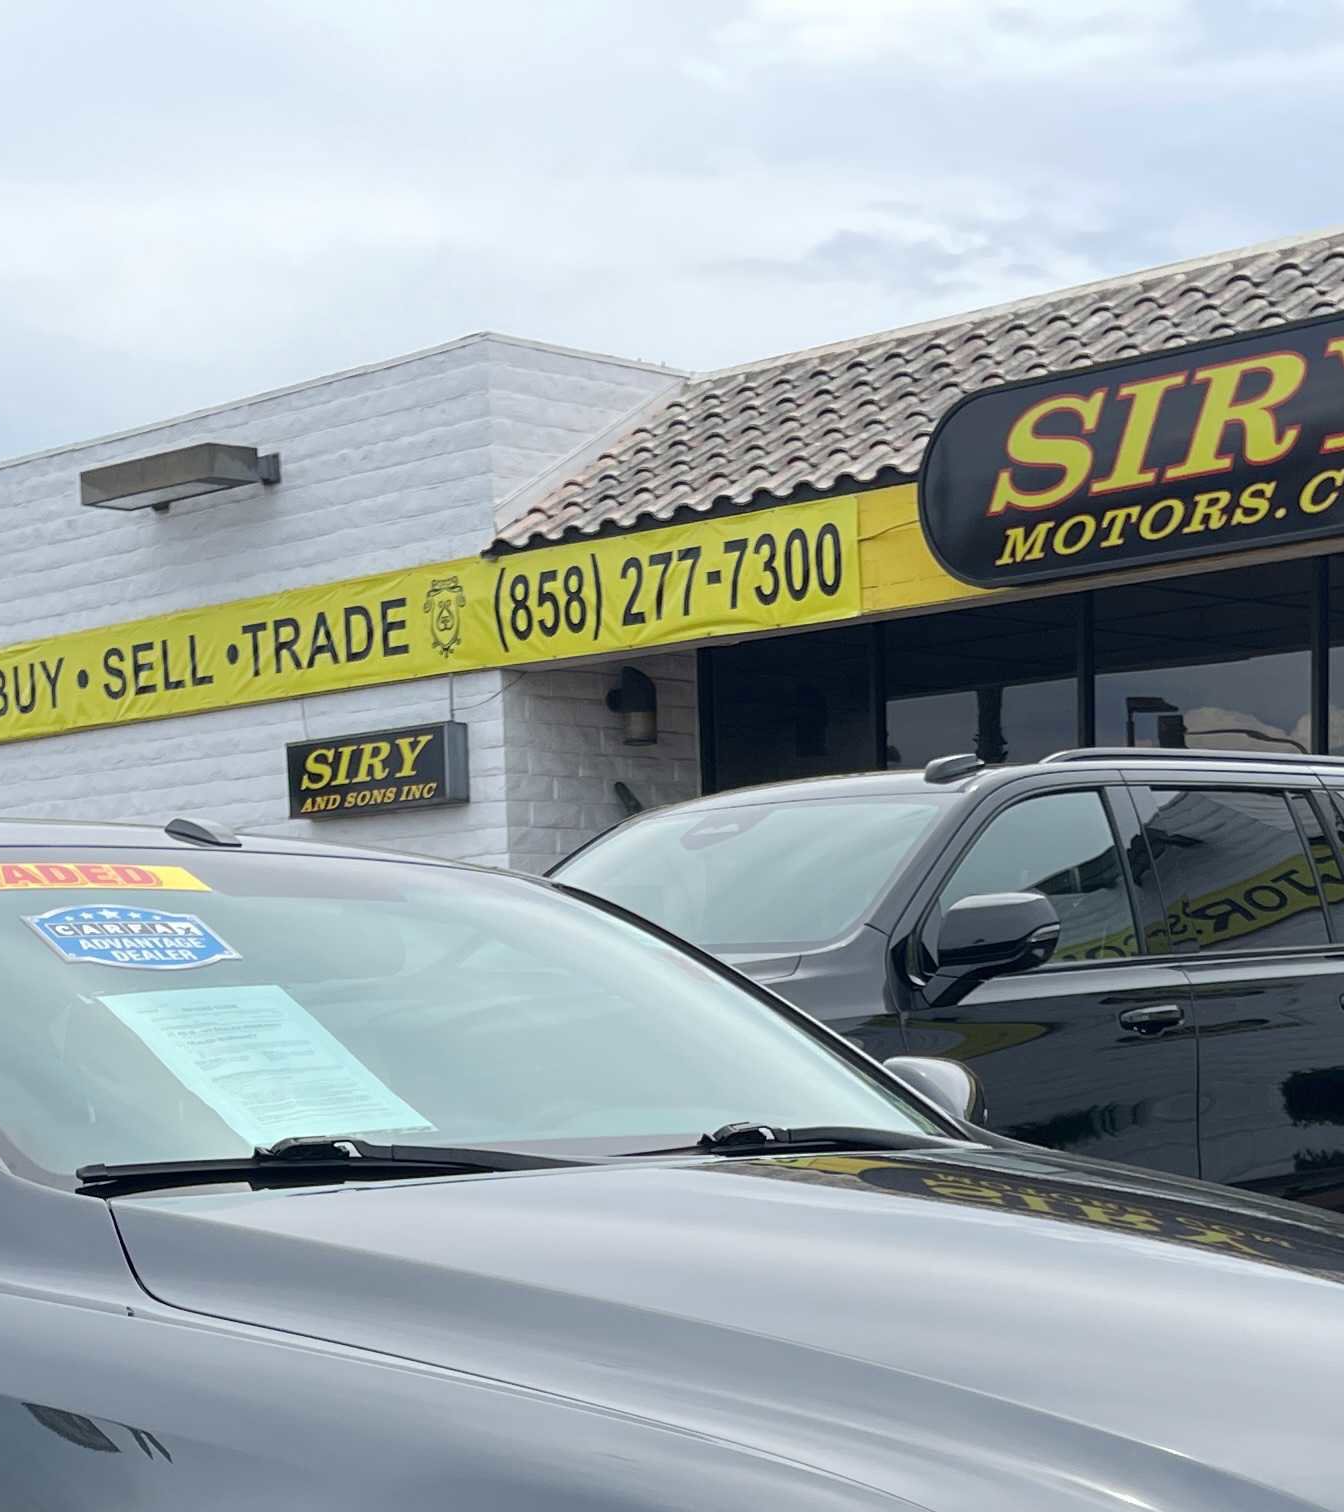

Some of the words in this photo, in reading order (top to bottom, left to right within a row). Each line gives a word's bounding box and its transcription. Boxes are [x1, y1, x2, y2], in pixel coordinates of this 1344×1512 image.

[493, 553, 602, 652] (858)
[620, 522, 843, 627] 277-7300
[101, 634, 214, 700] SELL
[241, 597, 412, 669] TRADE
[300, 734, 434, 791] SIRY
[300, 794, 340, 813] AND
[344, 787, 397, 807] SONS
[399, 782, 437, 801] INC
[79, 937, 206, 951] ADVANTAGE
[111, 949, 199, 962] DEALER
